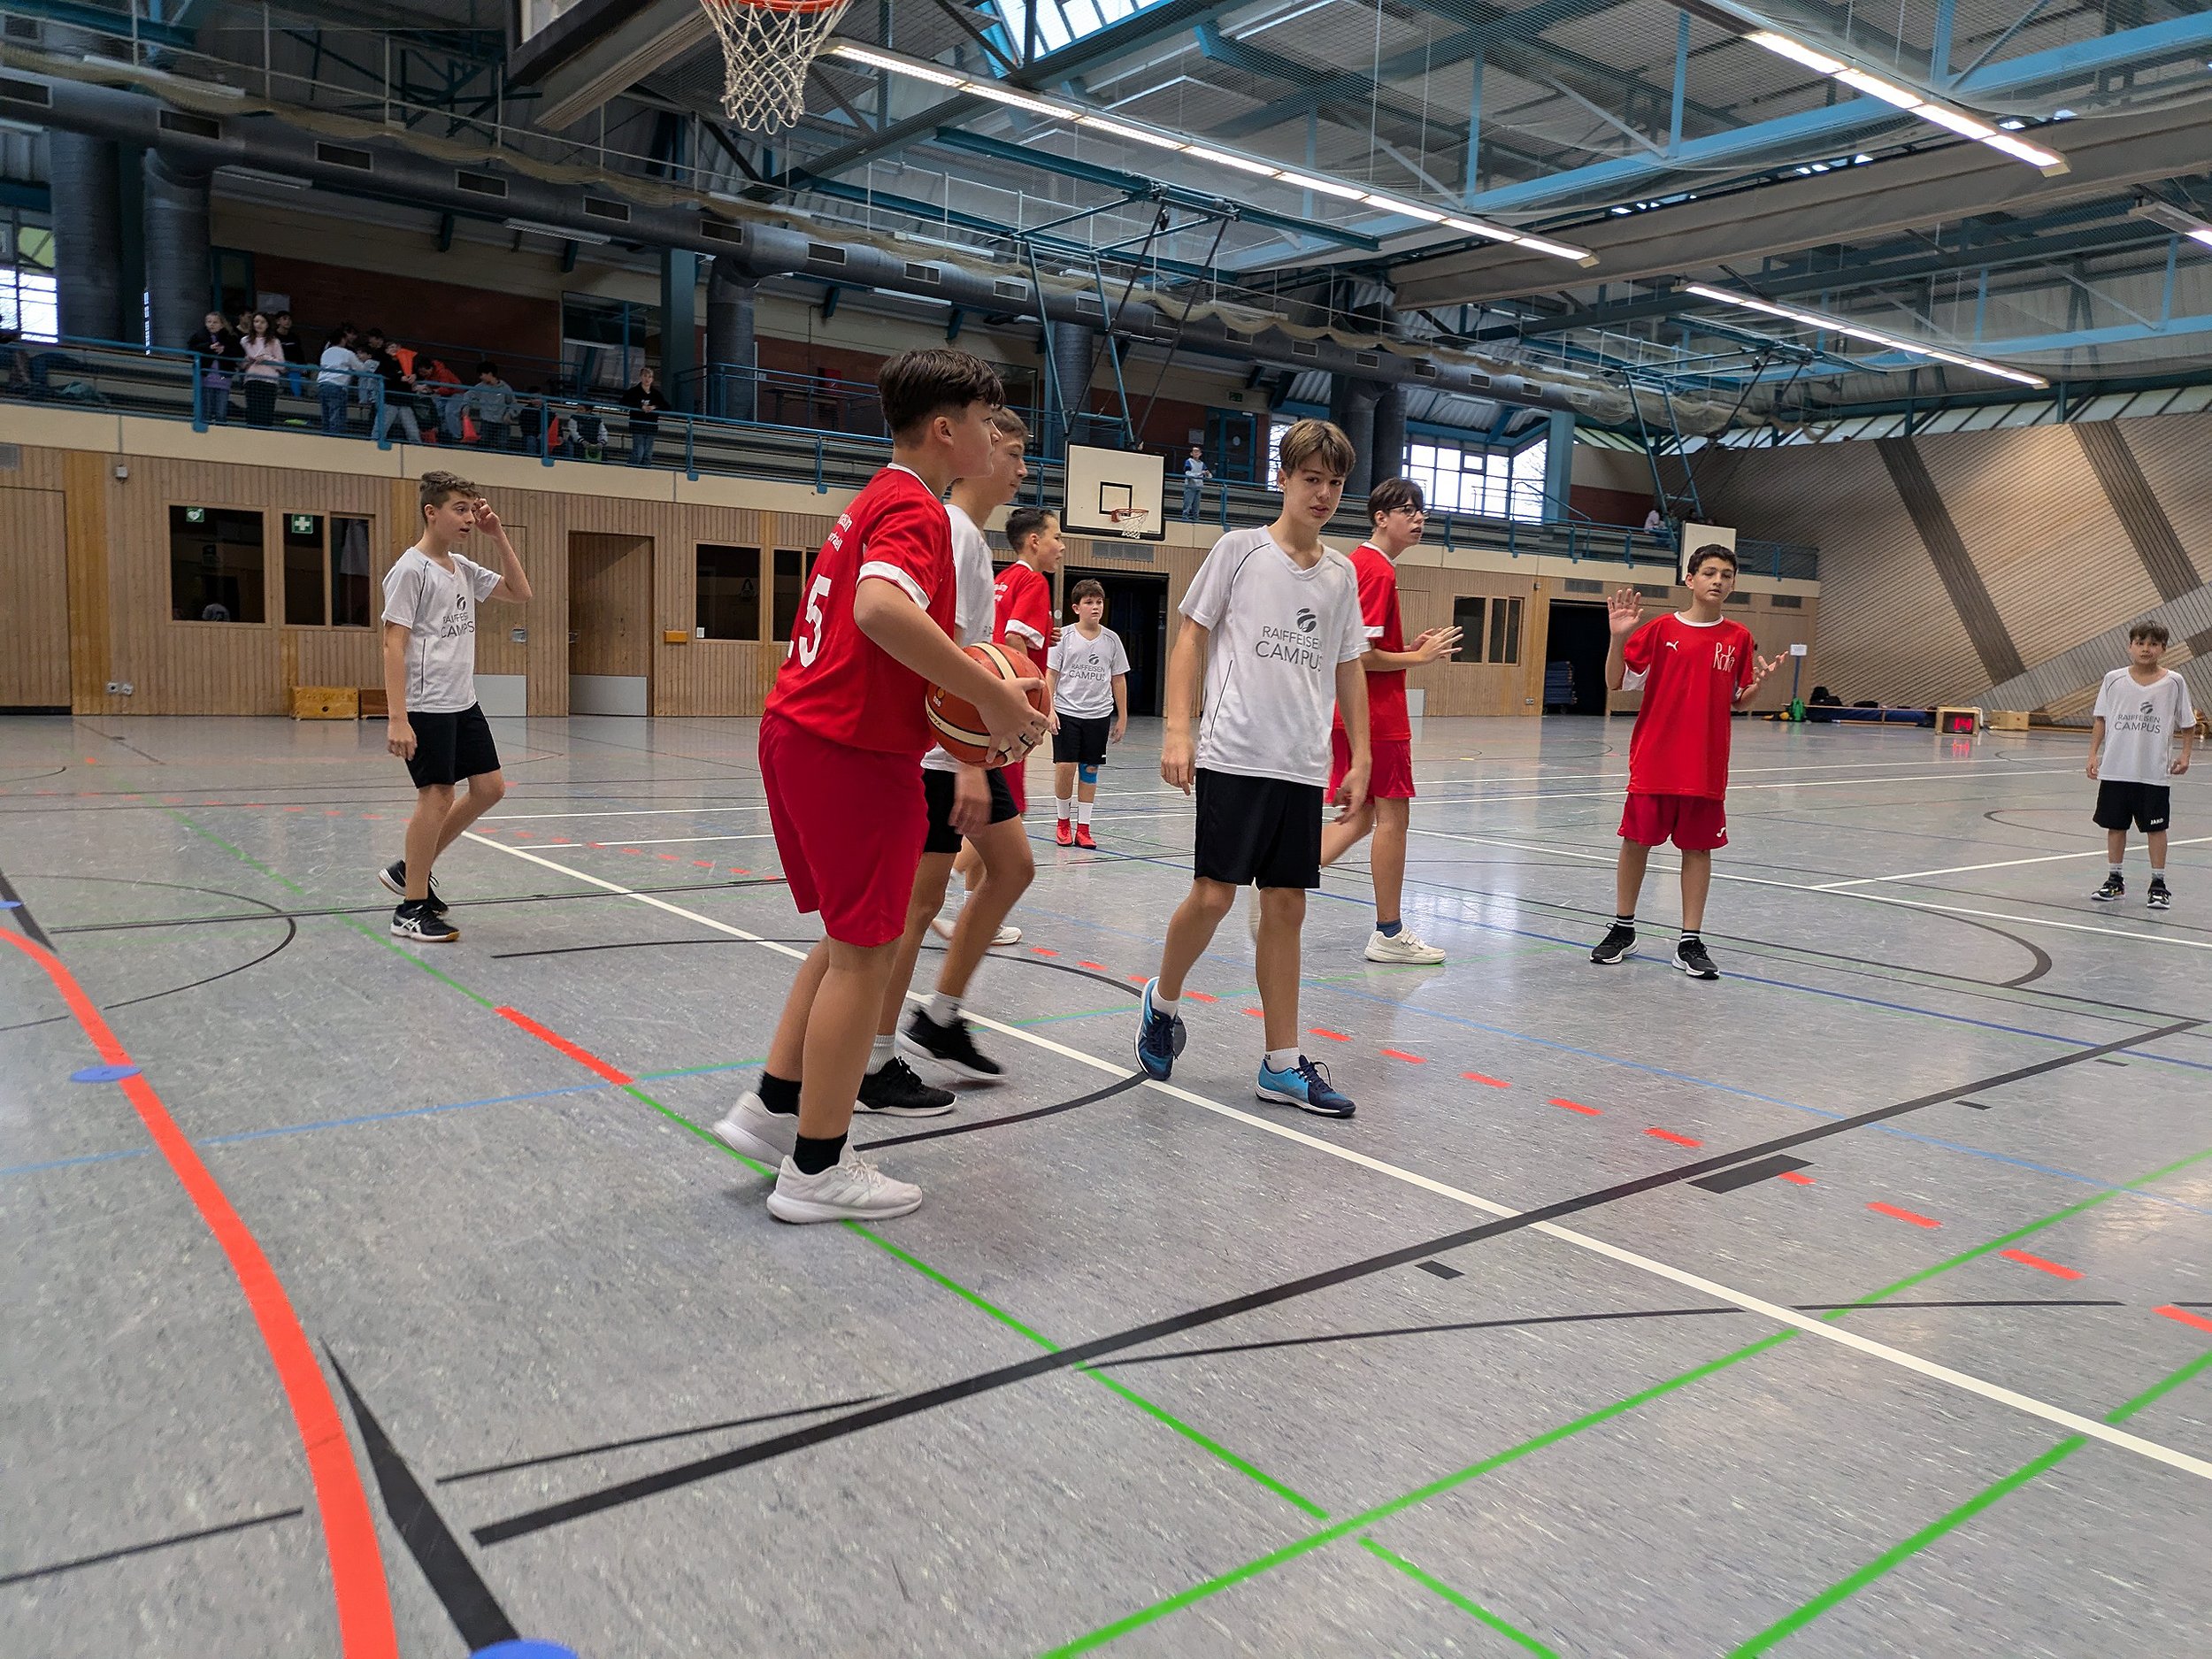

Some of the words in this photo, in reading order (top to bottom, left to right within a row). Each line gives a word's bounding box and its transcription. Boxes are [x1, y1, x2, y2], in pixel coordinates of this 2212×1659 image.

[1071, 664, 1104, 672] RAIFFEISEN
[1069, 670, 1105, 681] CAMPUS
[2118, 714, 2161, 723] RAIFFEISEN
[2115, 721, 2161, 733] CAMPUS
